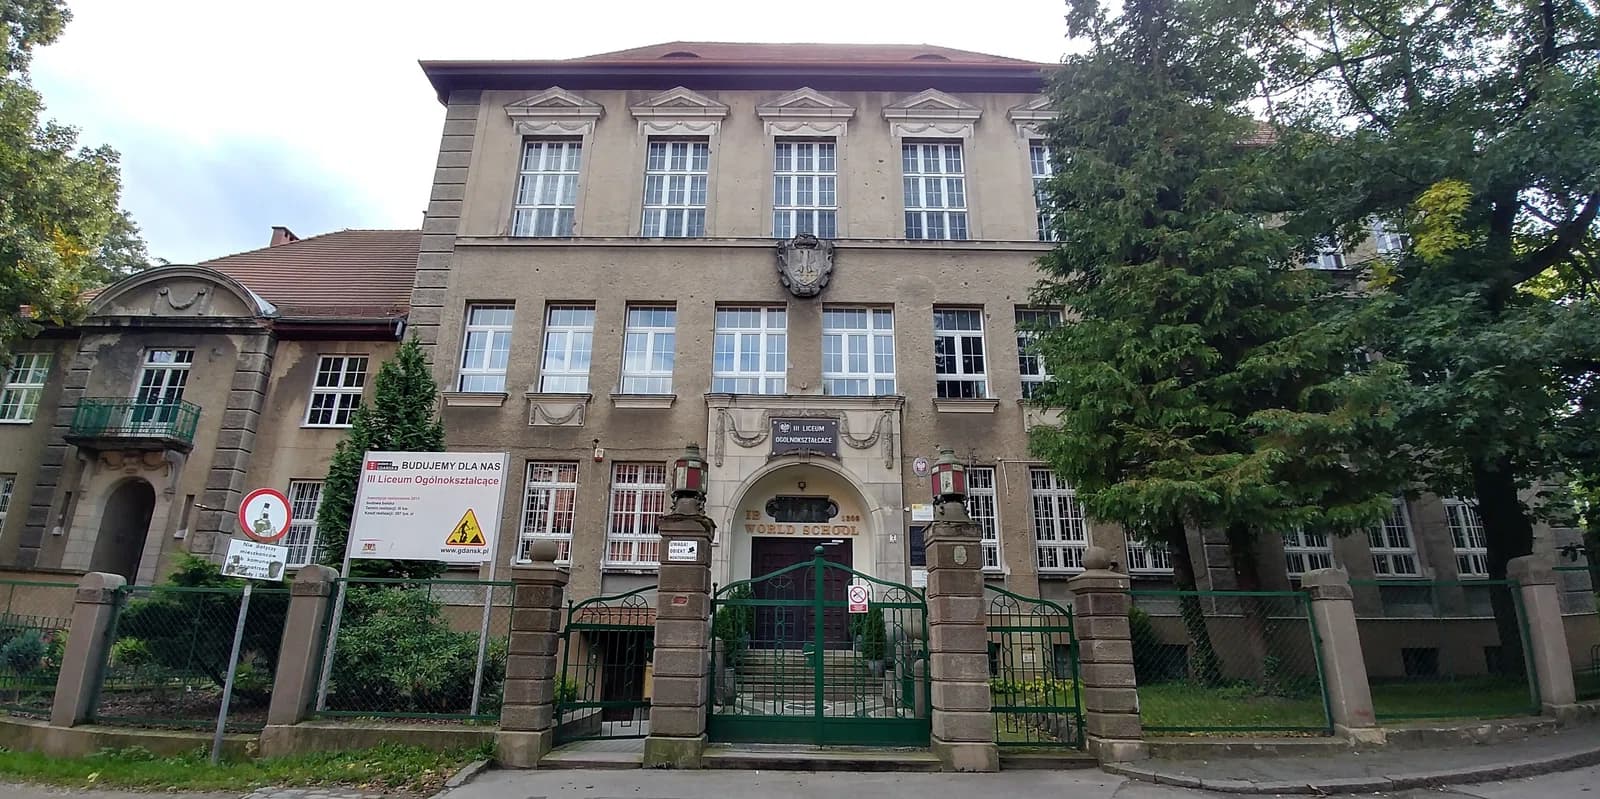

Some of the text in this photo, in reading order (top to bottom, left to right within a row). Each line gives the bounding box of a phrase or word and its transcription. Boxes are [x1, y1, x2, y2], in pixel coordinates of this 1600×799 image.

[402, 461, 456, 471] BUDUJEMY
[458, 462, 478, 471] DLA
[480, 462, 501, 471] NAS
[367, 475, 499, 486] III Liceum Ogólnokształcące
[745, 510, 760, 520] IB
[744, 524, 860, 535] WORLD SCHOOL
[440, 547, 490, 555] www.gdansk.pl
